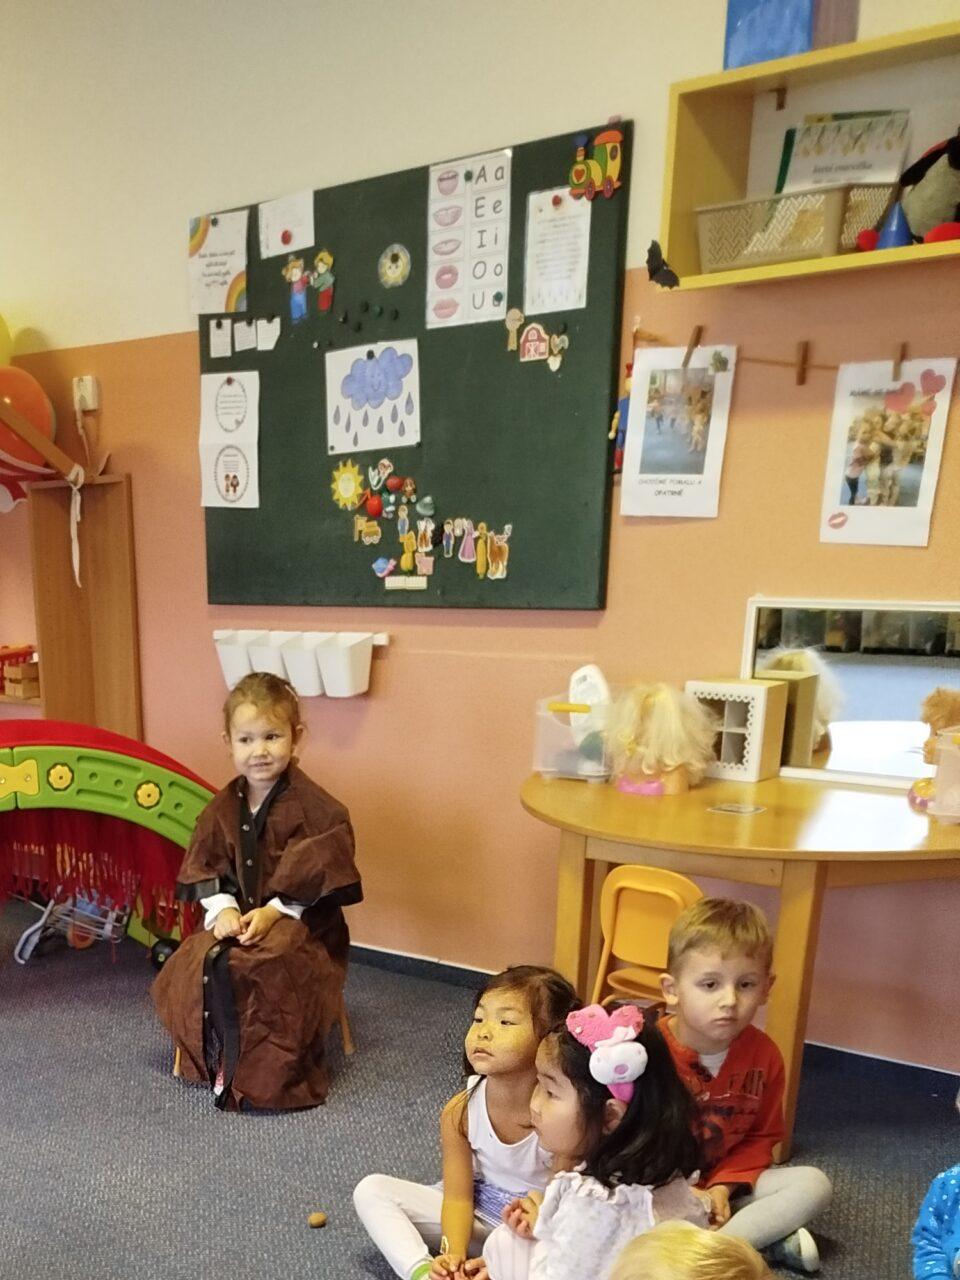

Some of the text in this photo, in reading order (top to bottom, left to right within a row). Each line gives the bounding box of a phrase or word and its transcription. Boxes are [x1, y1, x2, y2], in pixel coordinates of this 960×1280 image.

[475, 166, 504, 185] A a
[475, 197, 503, 218] E e
[478, 227, 499, 249] I i
[472, 261, 503, 280] O o
[472, 291, 485, 310] U
